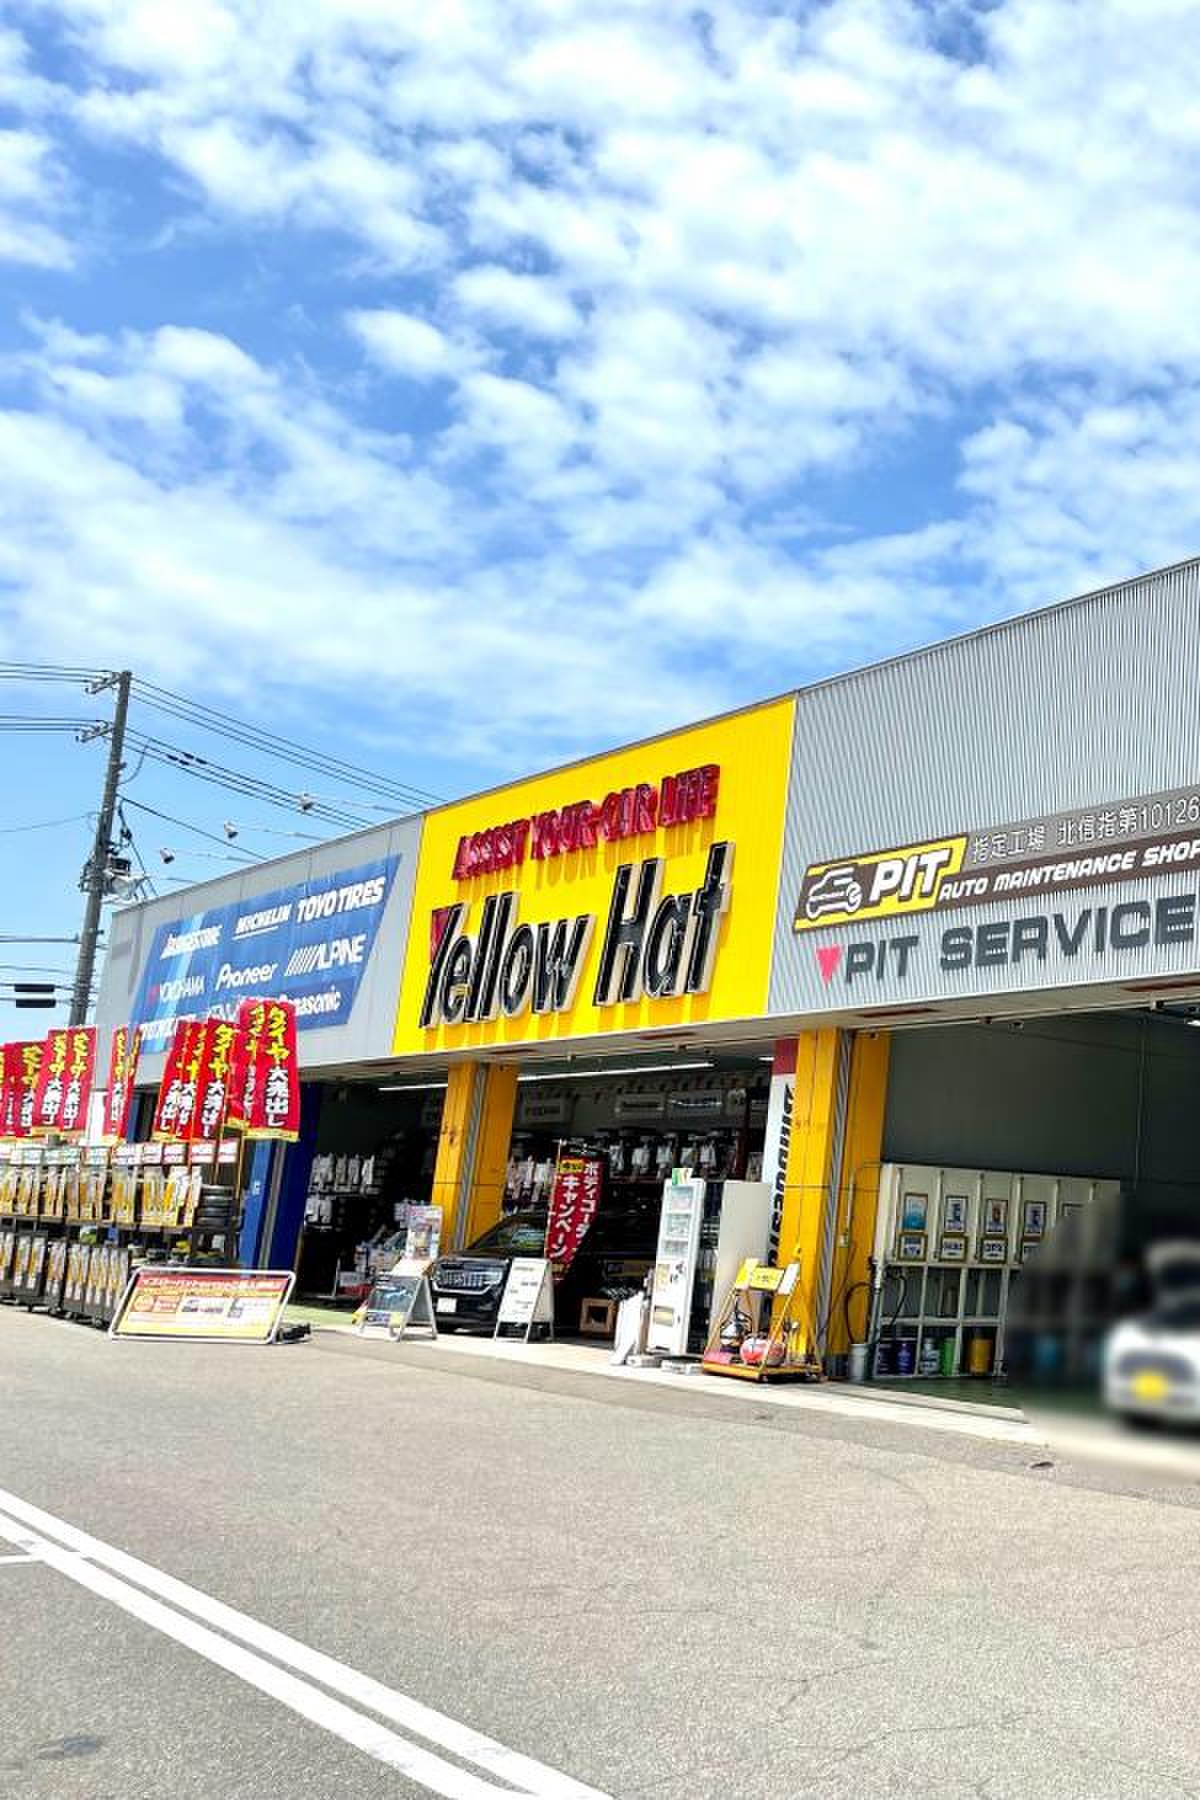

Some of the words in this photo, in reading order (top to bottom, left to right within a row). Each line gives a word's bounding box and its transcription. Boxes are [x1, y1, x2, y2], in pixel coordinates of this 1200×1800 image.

[972, 826, 1047, 864] 指定工場
[869, 849, 949, 902] PIT
[939, 877, 987, 900] AUTO
[994, 852, 1135, 890] MAINTENANCE
[418, 891, 594, 1029] Yellow
[592, 841, 735, 1007] Hat
[846, 934, 919, 983] PIT
[941, 894, 1197, 972] SERVICE
[215, 961, 278, 992] Pioneer
[549, 1175, 580, 1258] キャンペーン
